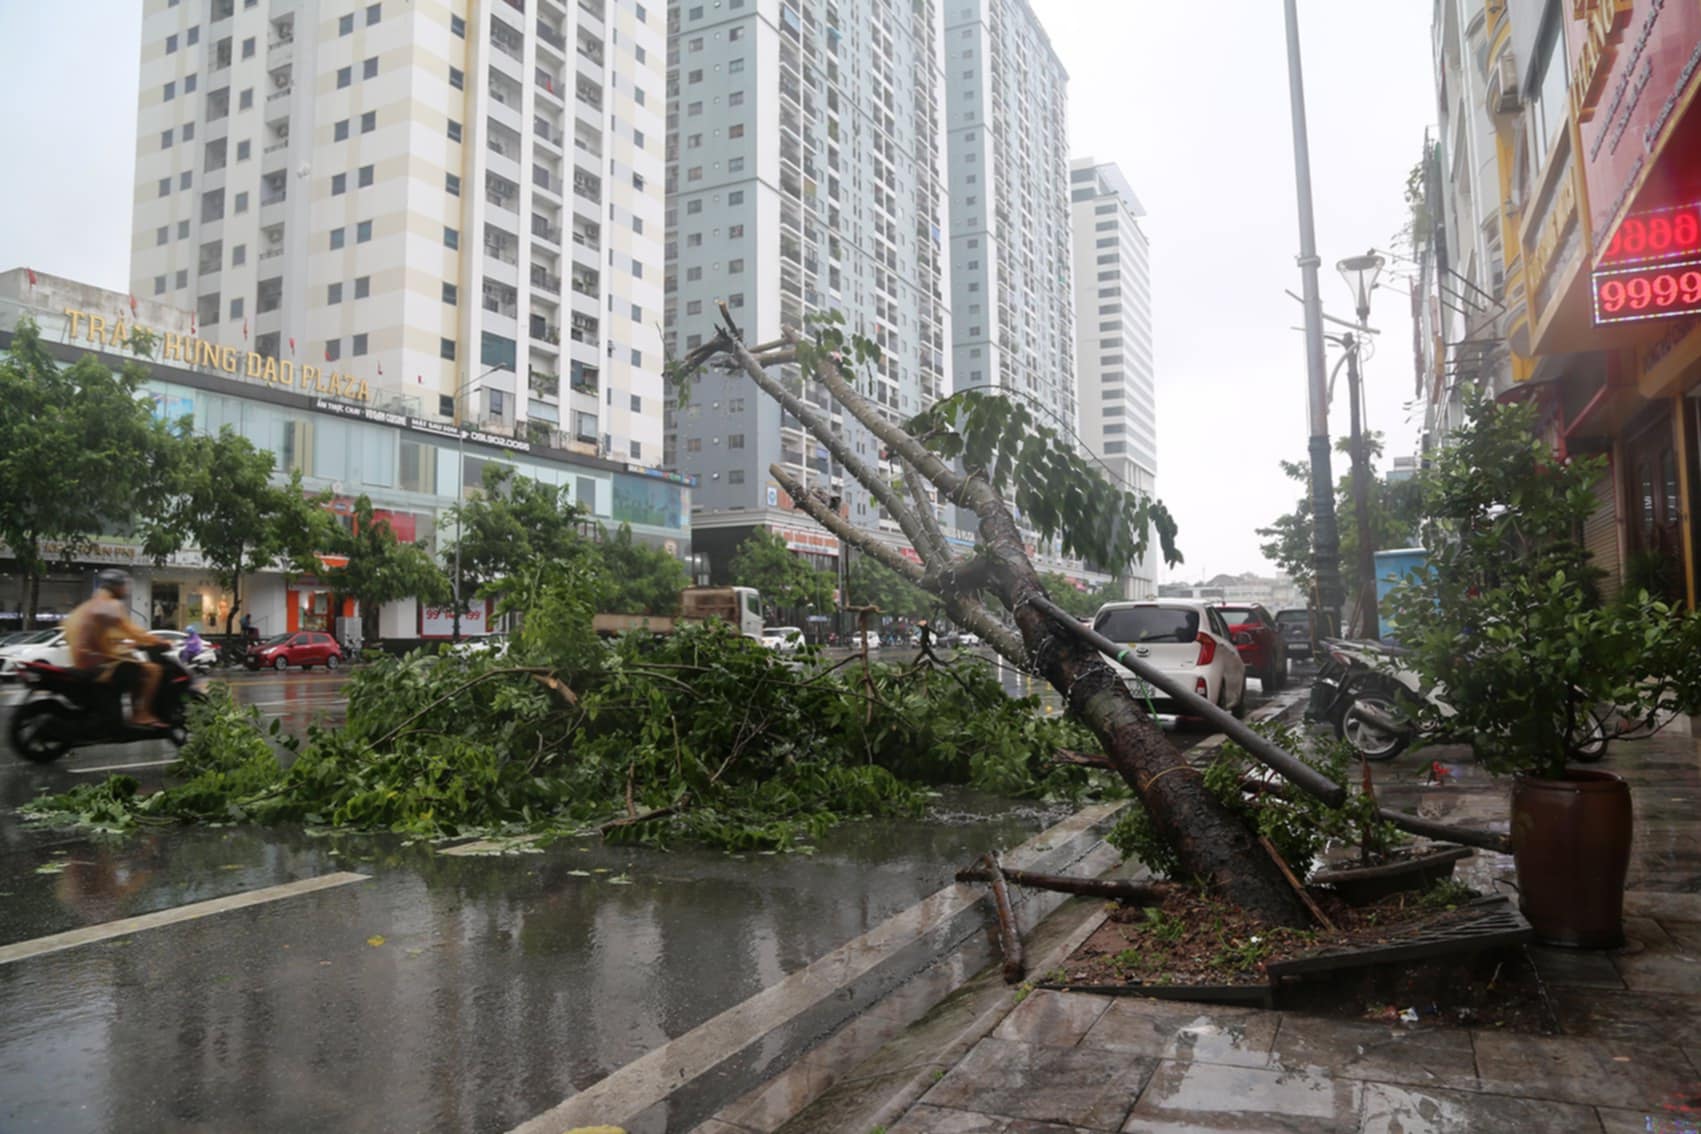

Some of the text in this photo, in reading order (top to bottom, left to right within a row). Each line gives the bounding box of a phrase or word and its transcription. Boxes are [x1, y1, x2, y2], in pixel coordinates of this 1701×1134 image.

[1600, 271, 1701, 312] 9999
[64, 307, 154, 350] TRẦ
[302, 364, 369, 401] PLAZA
